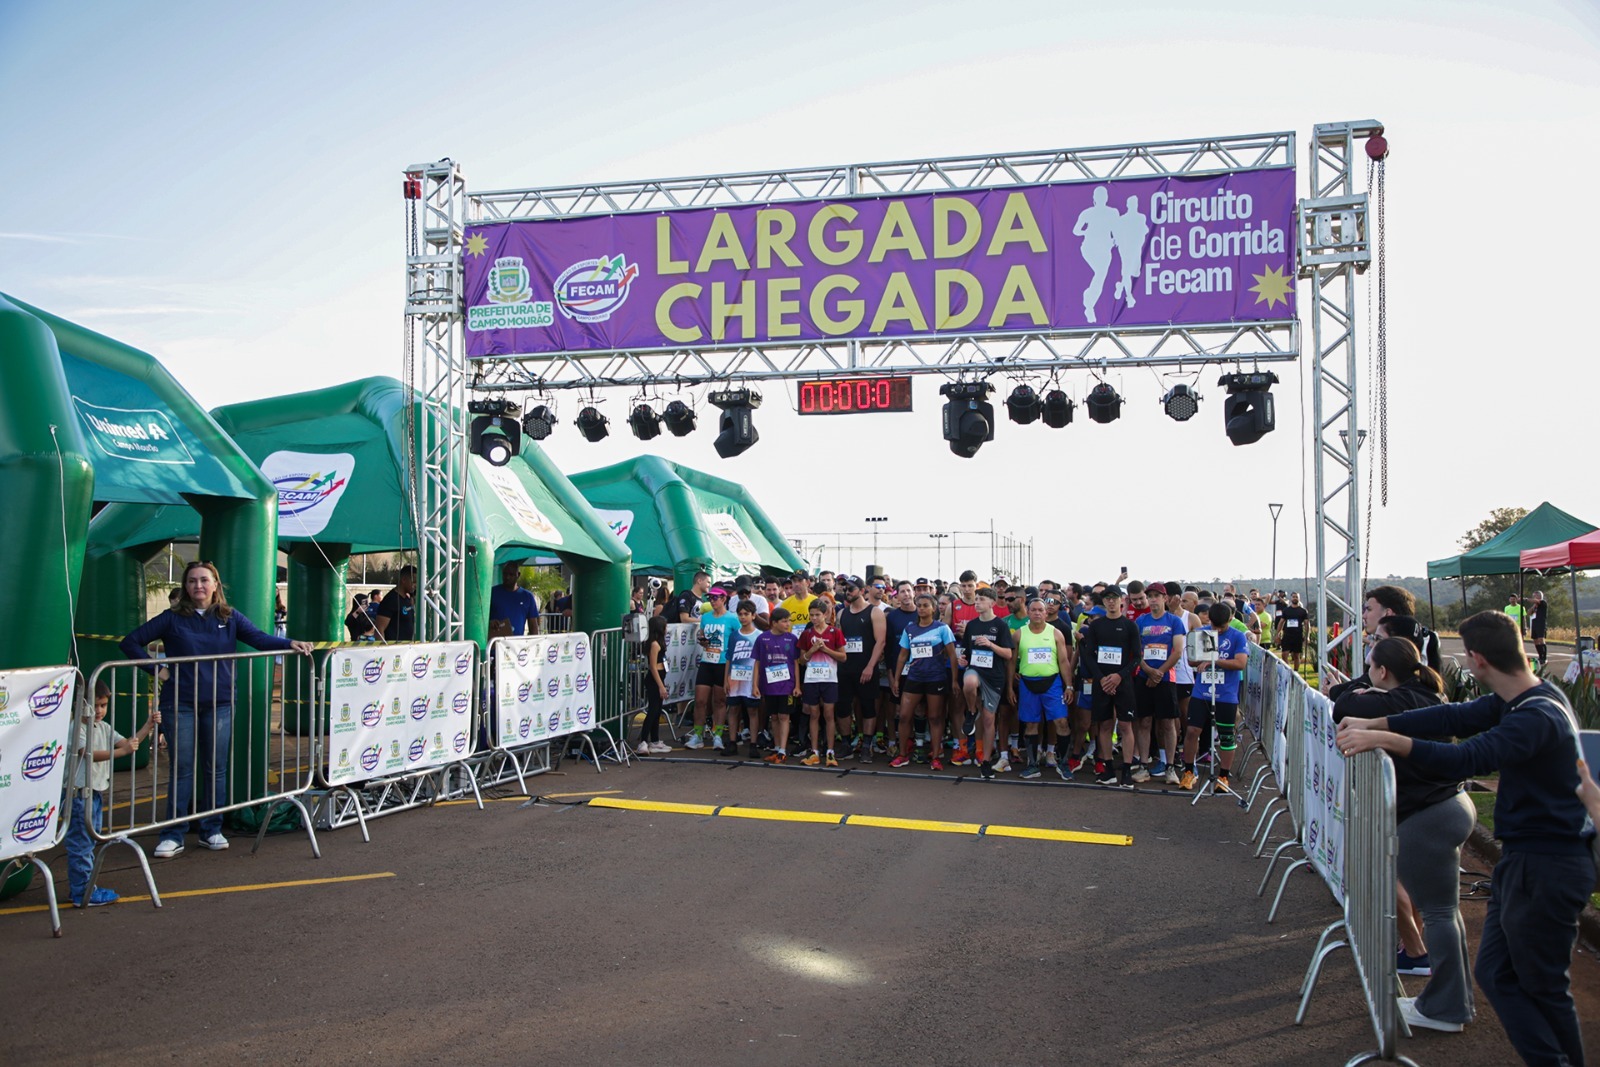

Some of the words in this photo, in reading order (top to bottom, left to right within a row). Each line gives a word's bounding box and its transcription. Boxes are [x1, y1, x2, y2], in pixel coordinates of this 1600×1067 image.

[1150, 188, 1252, 224] Circuito
[656, 192, 1048, 275] LARGADA
[1150, 227, 1181, 260] de
[1189, 220, 1285, 259] Corrida
[1145, 263, 1232, 295] Fecam
[570, 283, 615, 297] FECAM
[470, 305, 534, 318] PREFEITURA
[536, 304, 551, 313] DE
[655, 265, 1049, 343] CHEGADA
[470, 317, 506, 329] CAMPO
[507, 313, 551, 326] MOURÃO
[85, 412, 150, 440] Unimed
[112, 438, 132, 452] Campo
[278, 491, 318, 501] ECAM
[790, 612, 811, 622] Cev
[37, 697, 58, 706] FECAM
[28, 757, 52, 767] FECAM
[19, 820, 44, 830] FECAM
